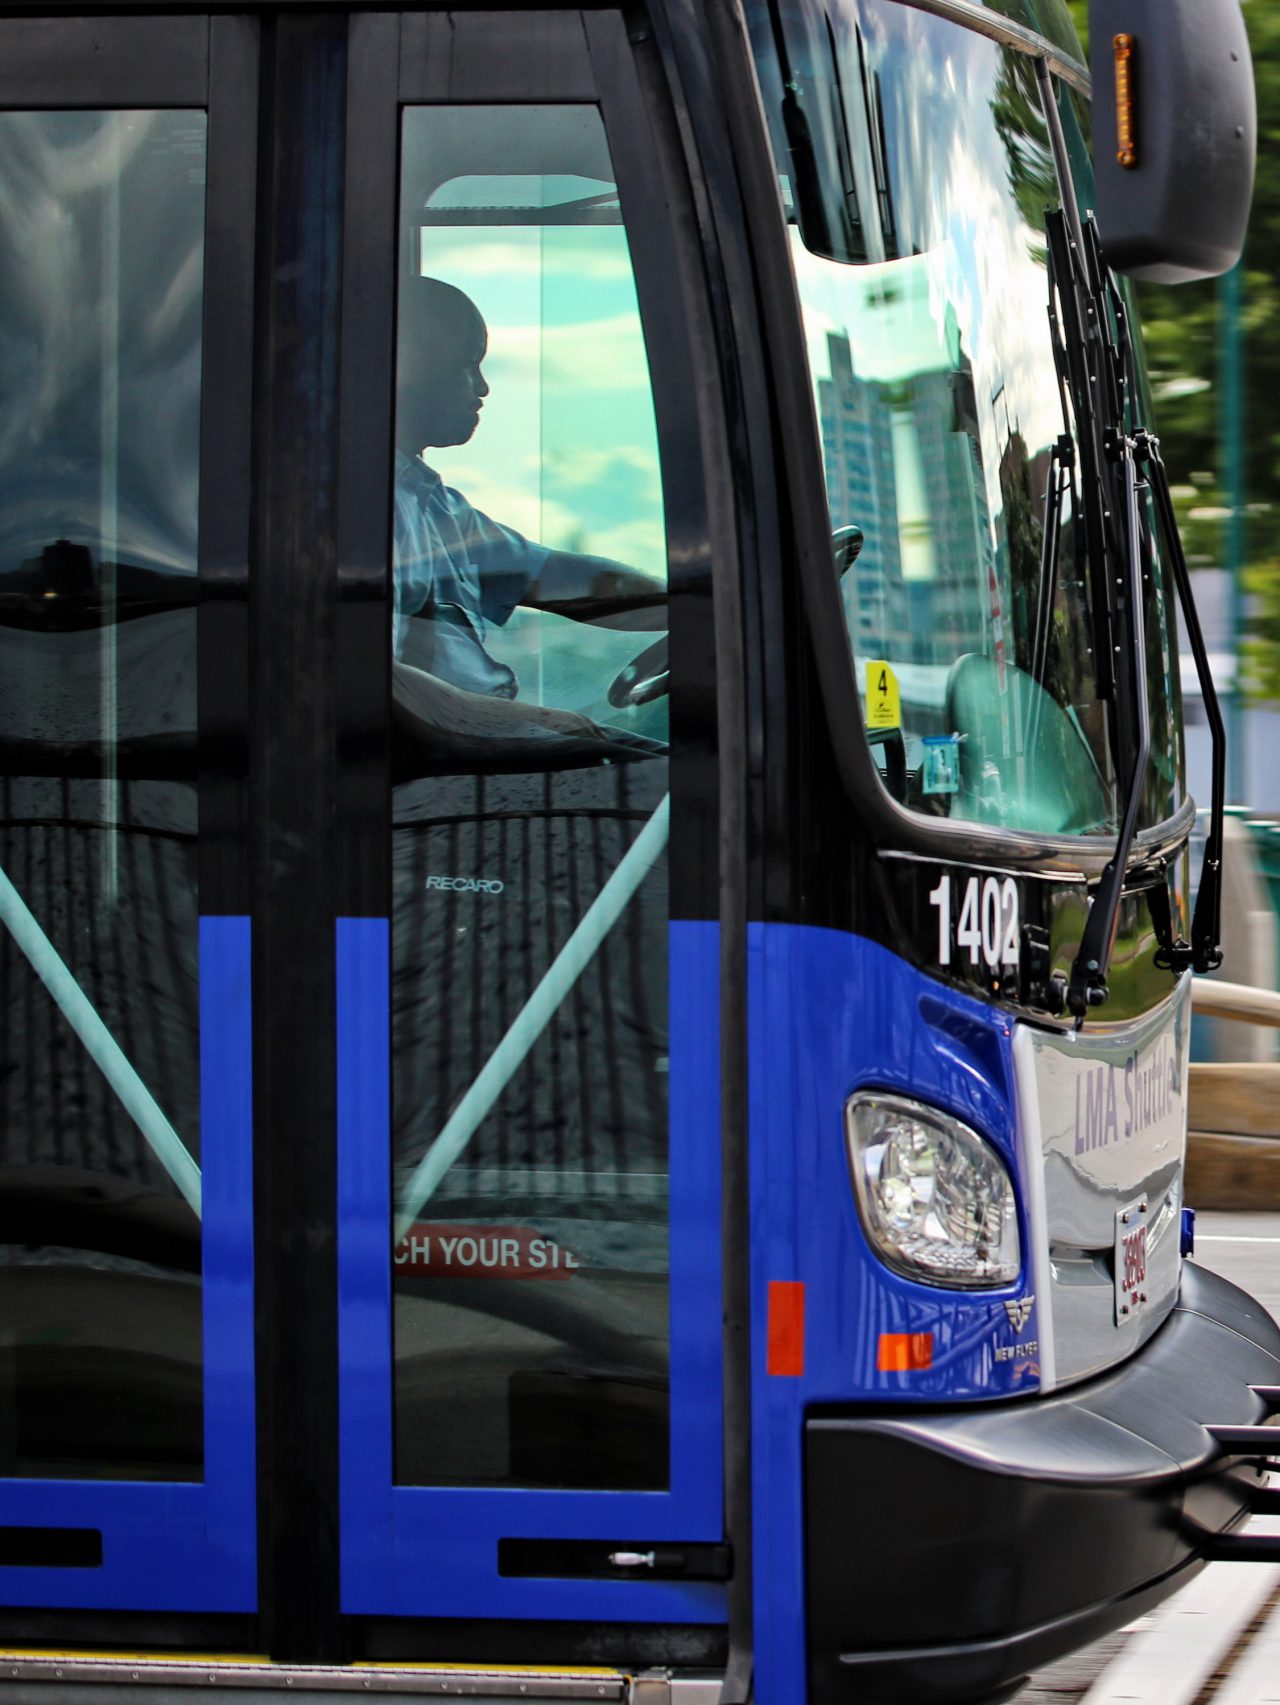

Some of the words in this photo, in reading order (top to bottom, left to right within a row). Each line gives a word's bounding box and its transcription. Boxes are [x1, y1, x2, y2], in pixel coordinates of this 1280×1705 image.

[878, 669, 888, 696] 4
[425, 876, 504, 894] RECARO
[929, 875, 1020, 966] 1402
[1075, 1064, 1118, 1156] LMA
[1124, 1036, 1176, 1138] Shuttle
[438, 1237, 519, 1266] YOUR
